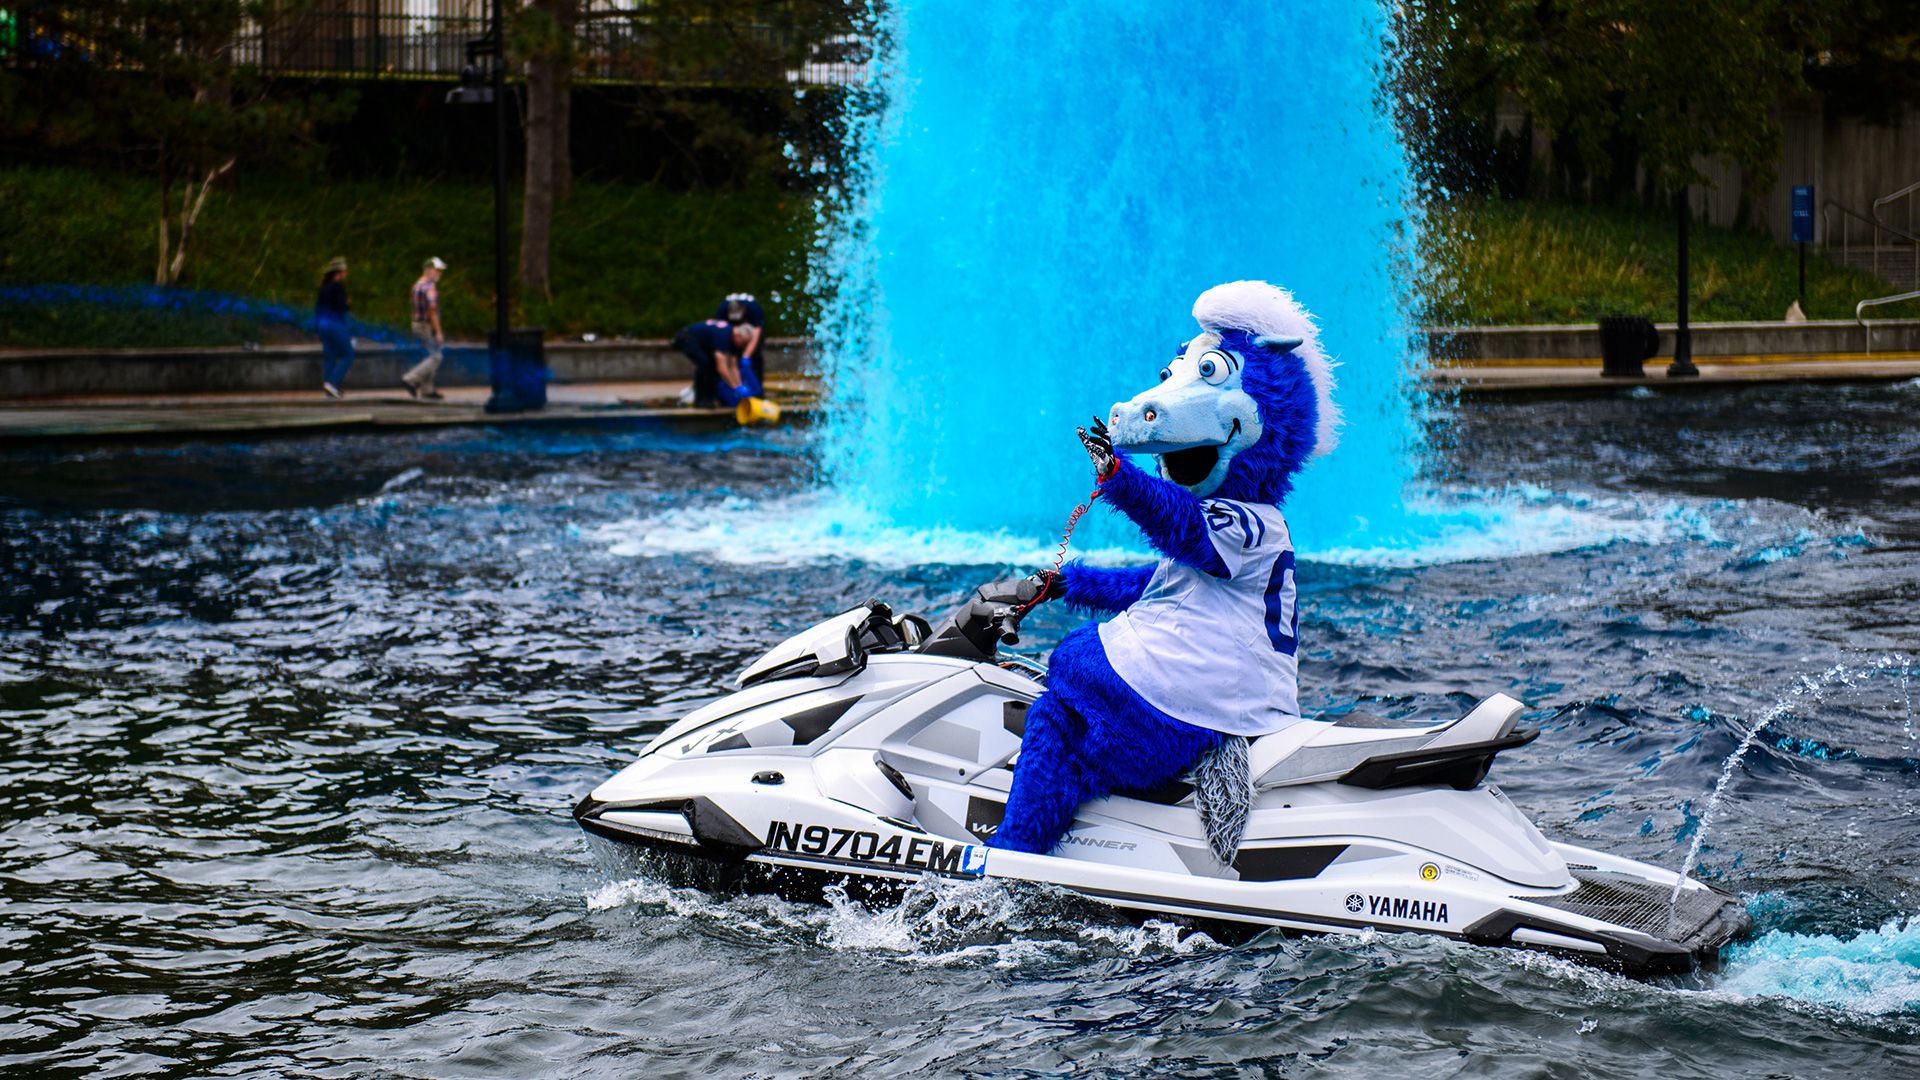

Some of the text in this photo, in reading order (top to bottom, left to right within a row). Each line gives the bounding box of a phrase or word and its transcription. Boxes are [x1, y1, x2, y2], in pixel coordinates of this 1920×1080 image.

[1264, 551, 1298, 656] 0
[681, 719, 745, 755] VX
[1369, 895, 1448, 923] YAMAHA
